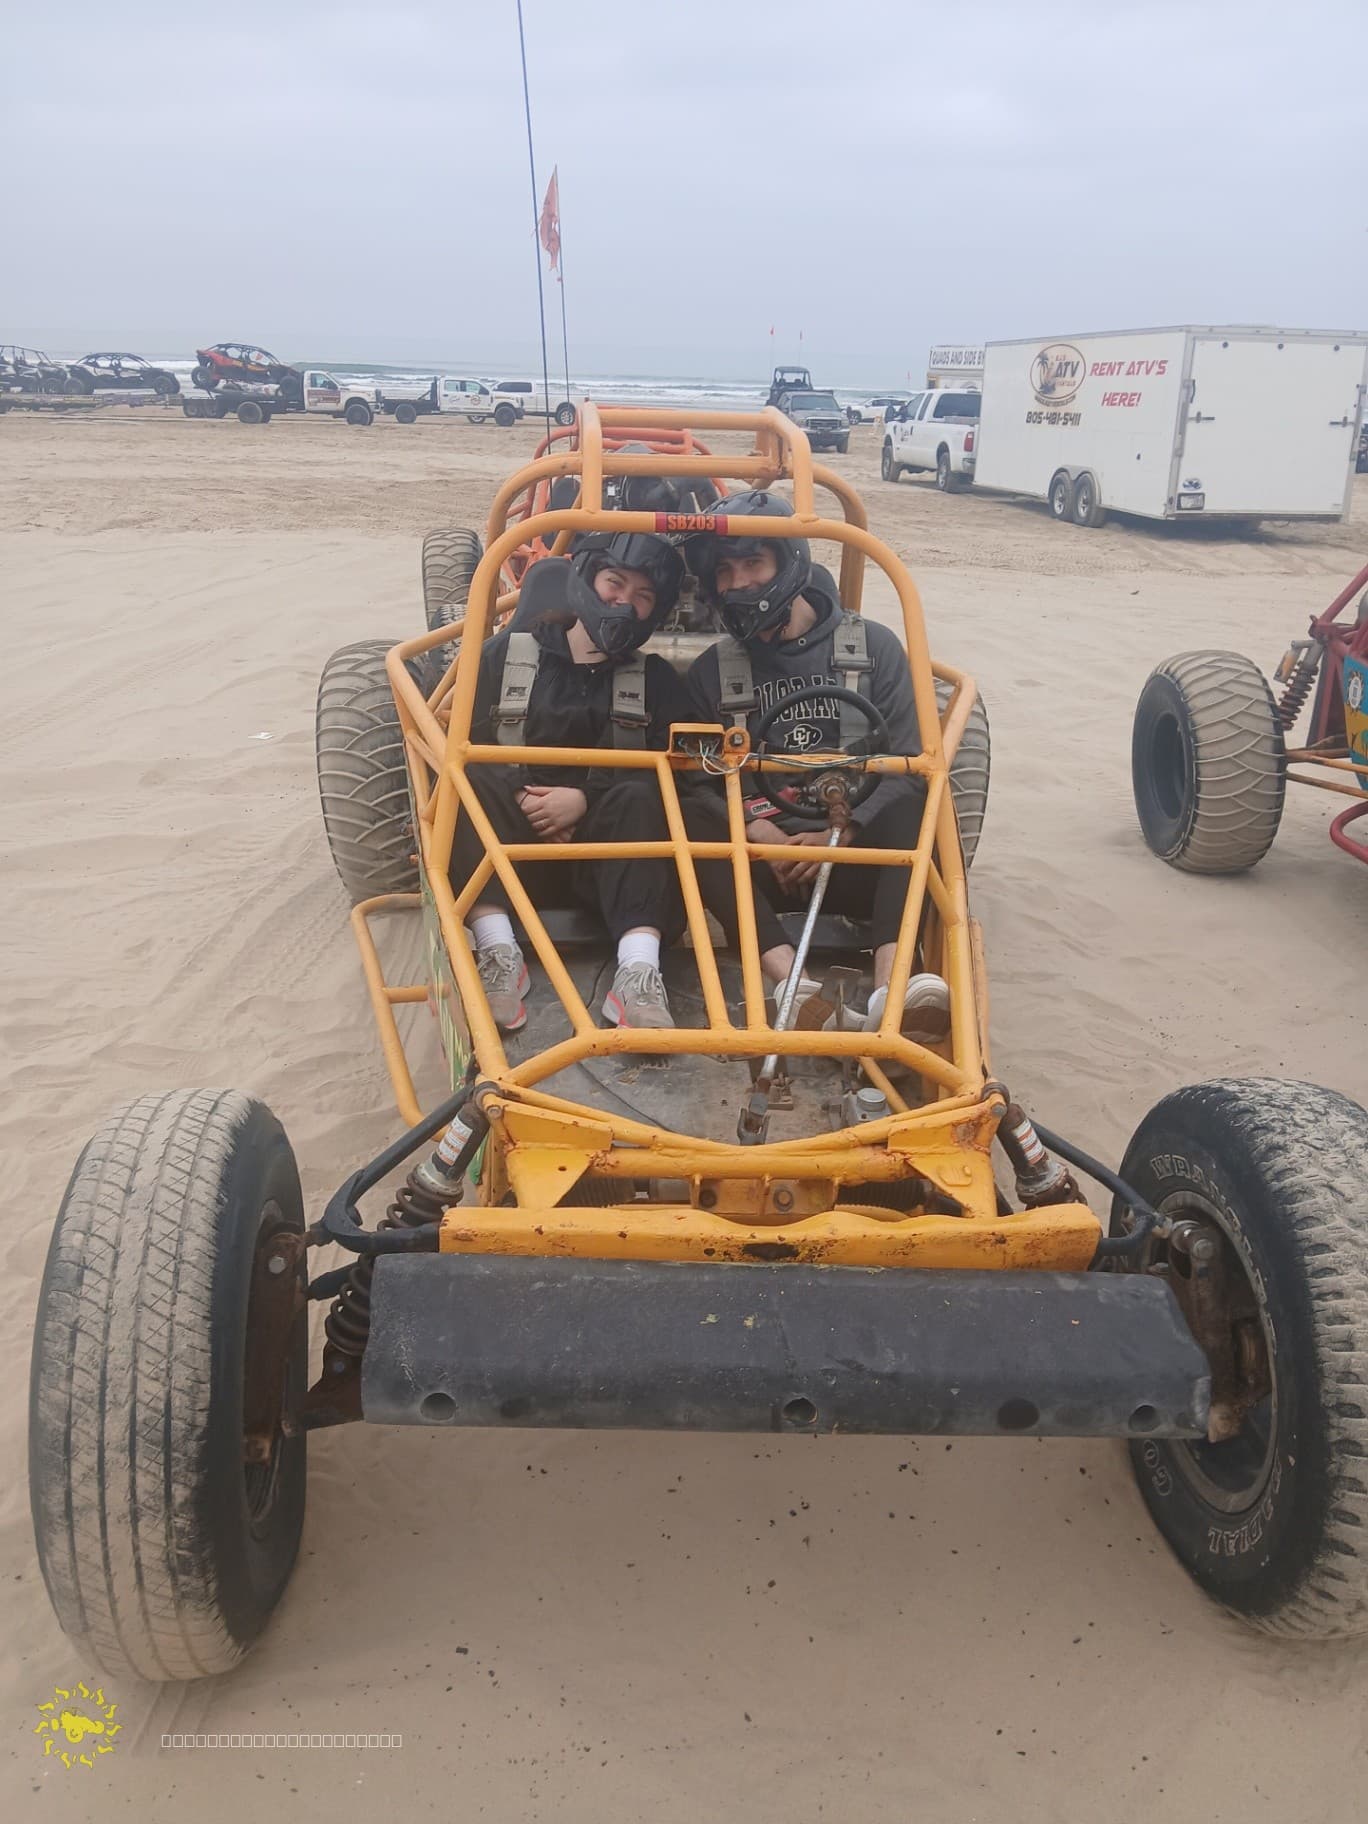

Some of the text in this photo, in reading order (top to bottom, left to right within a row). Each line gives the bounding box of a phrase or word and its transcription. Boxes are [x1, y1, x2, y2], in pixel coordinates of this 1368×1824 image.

[1054, 360, 1080, 378] ATV
[1089, 359, 1169, 377] RENT ATV'S
[1101, 391, 1142, 407] HERE!
[667, 514, 716, 531] SB203
